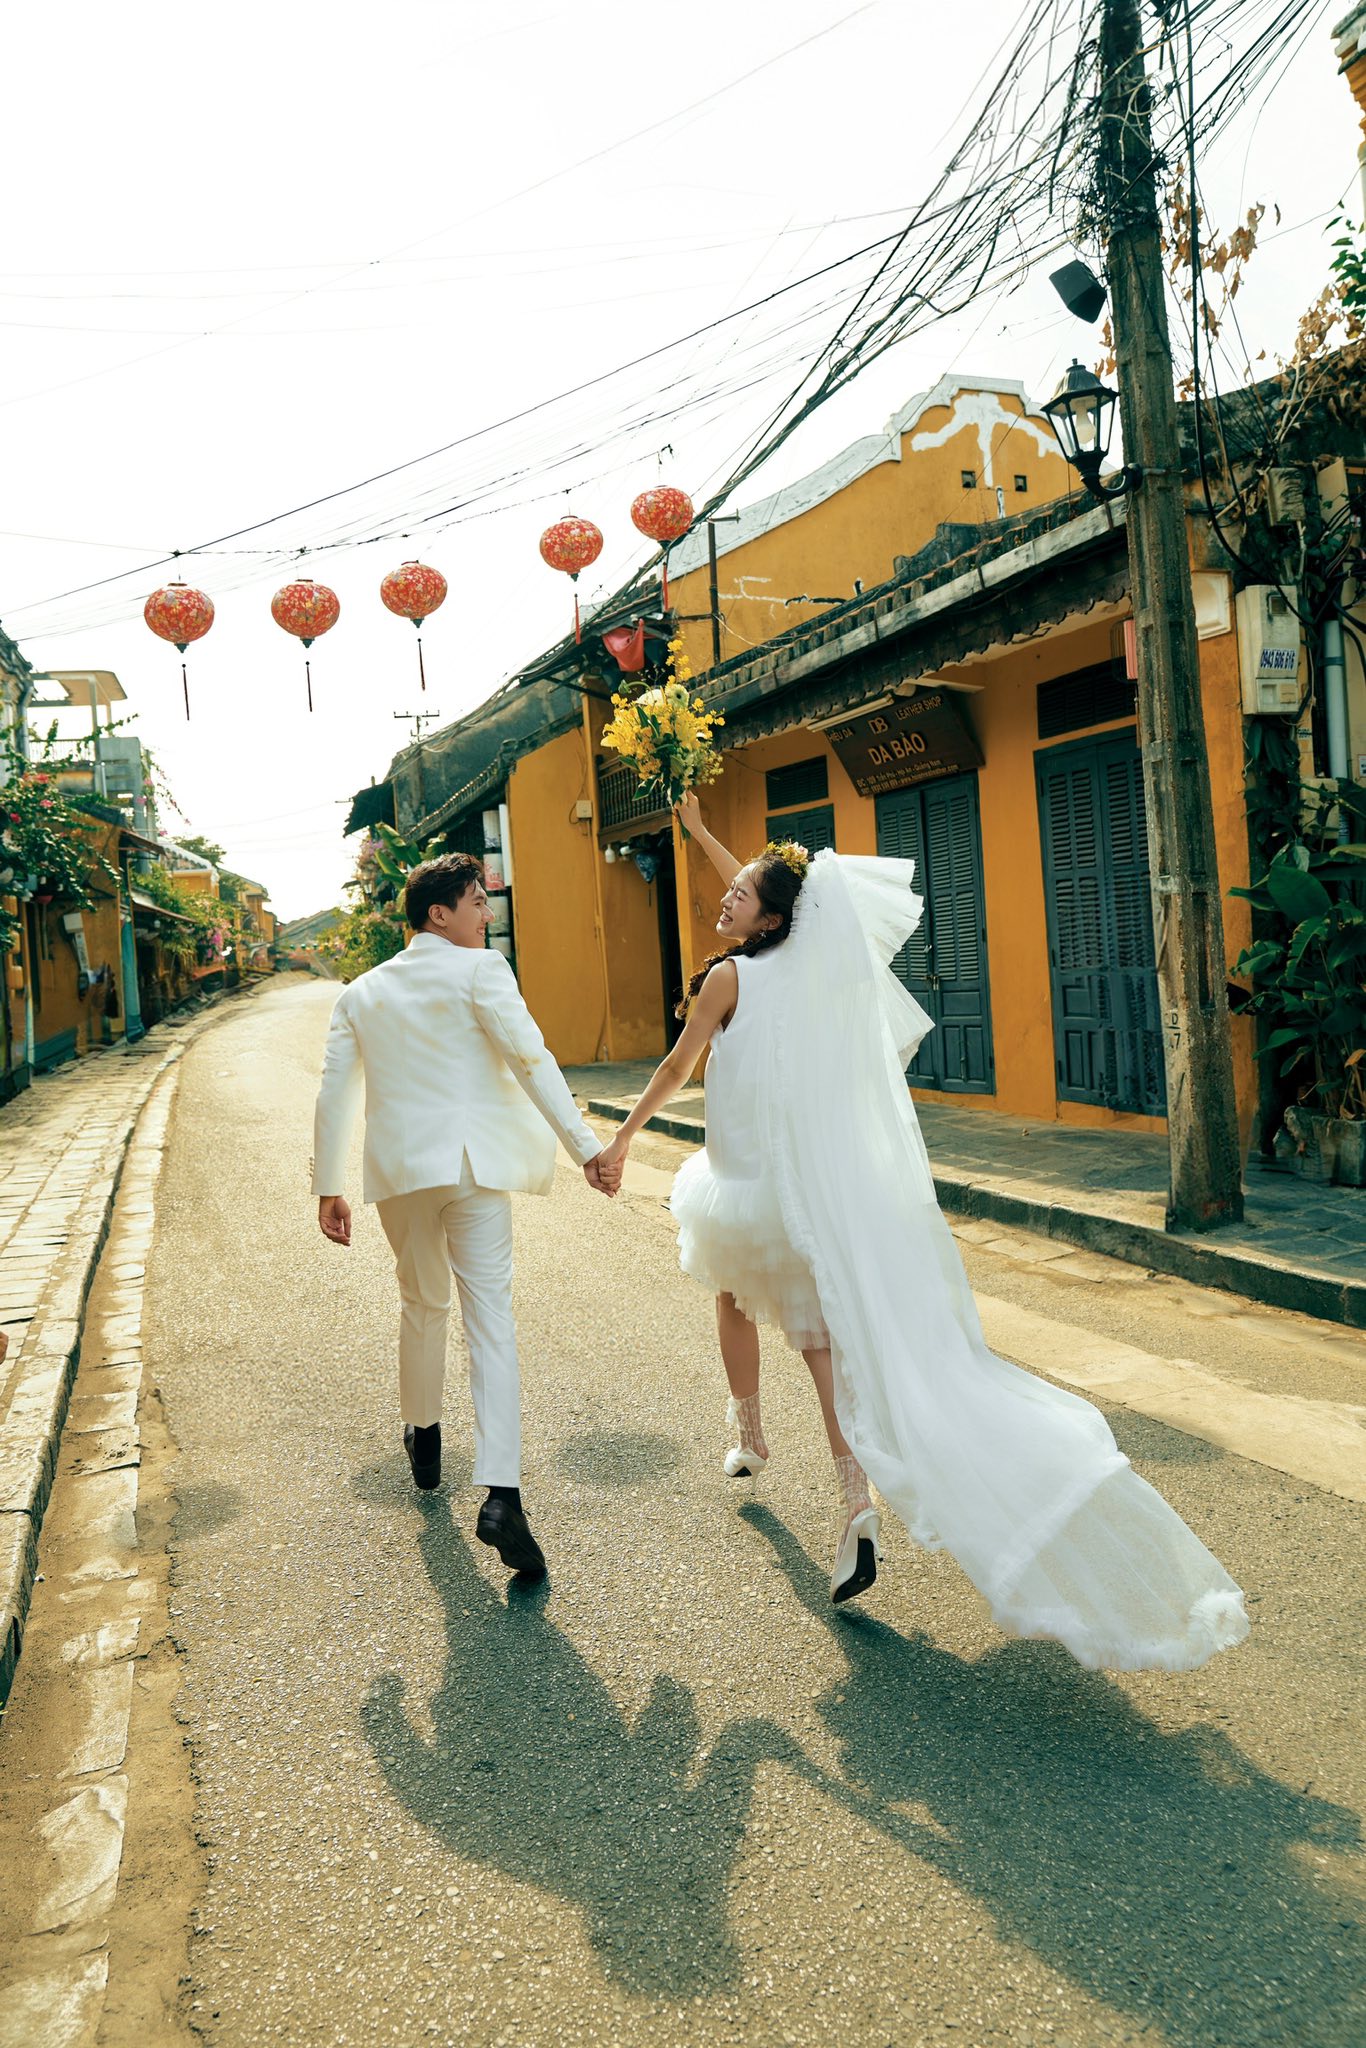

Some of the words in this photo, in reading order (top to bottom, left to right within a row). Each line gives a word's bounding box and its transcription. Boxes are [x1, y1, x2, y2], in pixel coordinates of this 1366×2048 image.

[895, 702, 924, 720] LEATHER
[923, 696, 942, 712] SHOP
[843, 728, 854, 738] DA
[868, 745, 893, 765] DA
[890, 732, 925, 759] BẢO
